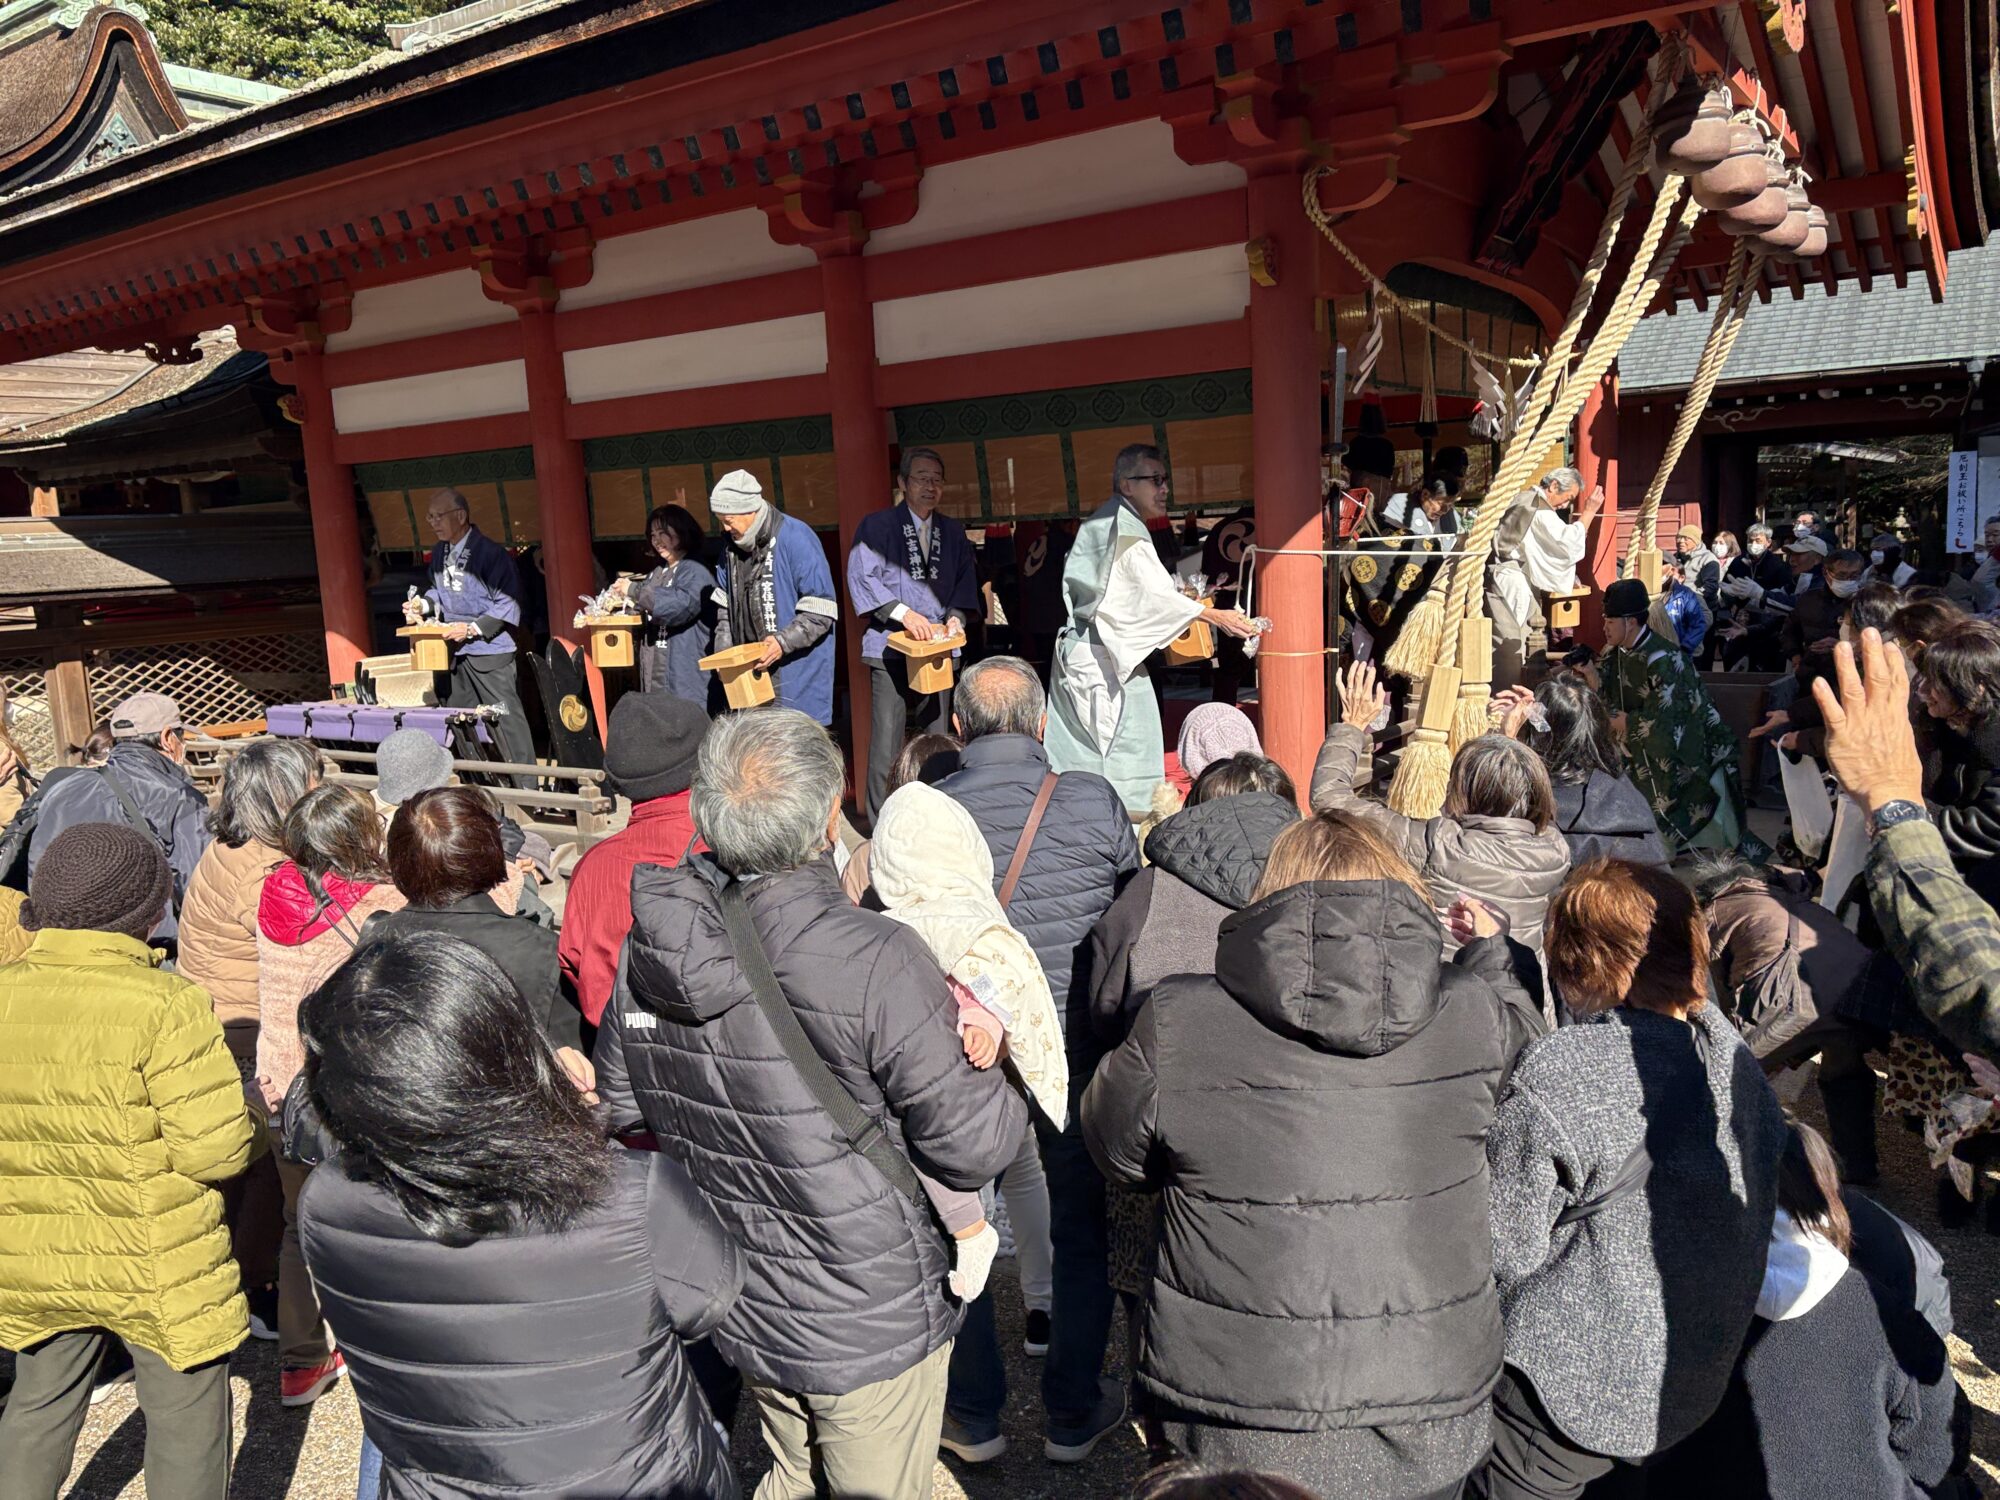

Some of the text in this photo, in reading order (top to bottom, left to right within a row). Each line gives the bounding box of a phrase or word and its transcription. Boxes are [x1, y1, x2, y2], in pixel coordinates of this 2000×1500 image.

[902, 523, 926, 580] 住吉神社
[624, 1011, 656, 1028] PUMA
